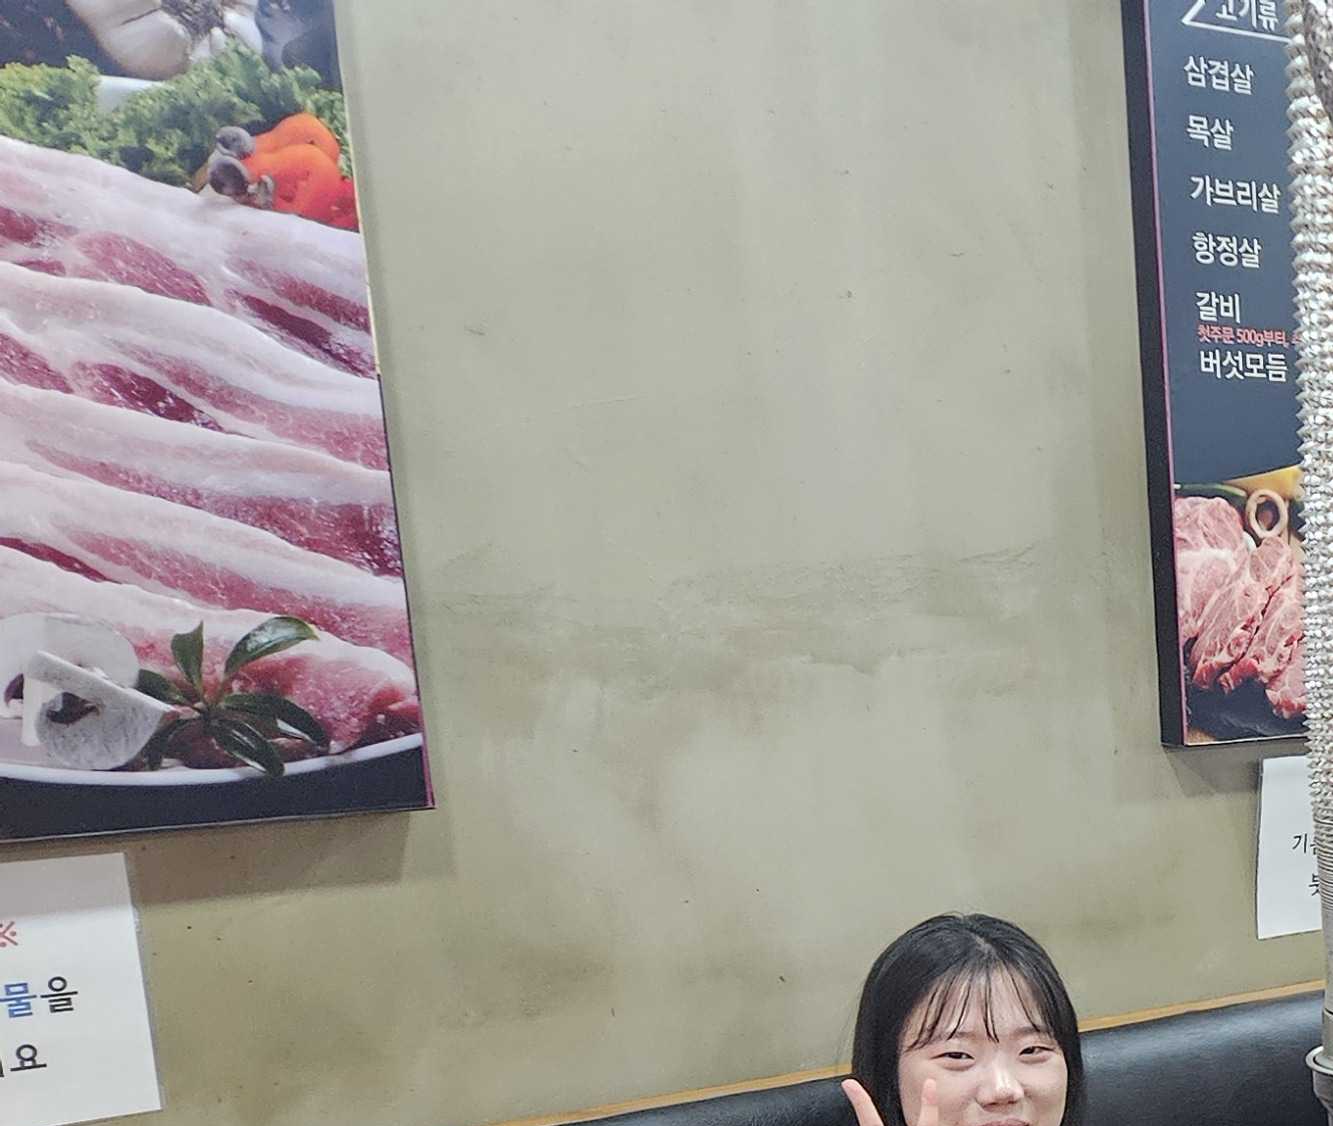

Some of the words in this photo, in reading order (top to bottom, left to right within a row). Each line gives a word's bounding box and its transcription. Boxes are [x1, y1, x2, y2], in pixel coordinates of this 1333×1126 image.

[1184, 55, 1254, 95] 삼겹살
[1187, 115, 1234, 150] 목살
[1190, 175, 1280, 213] 가브리살
[1192, 232, 1261, 268] 항정살
[1196, 291, 1240, 323] 갈비
[1198, 323, 1235, 345] 첫주문
[1200, 349, 1288, 382] 버섯모듬
